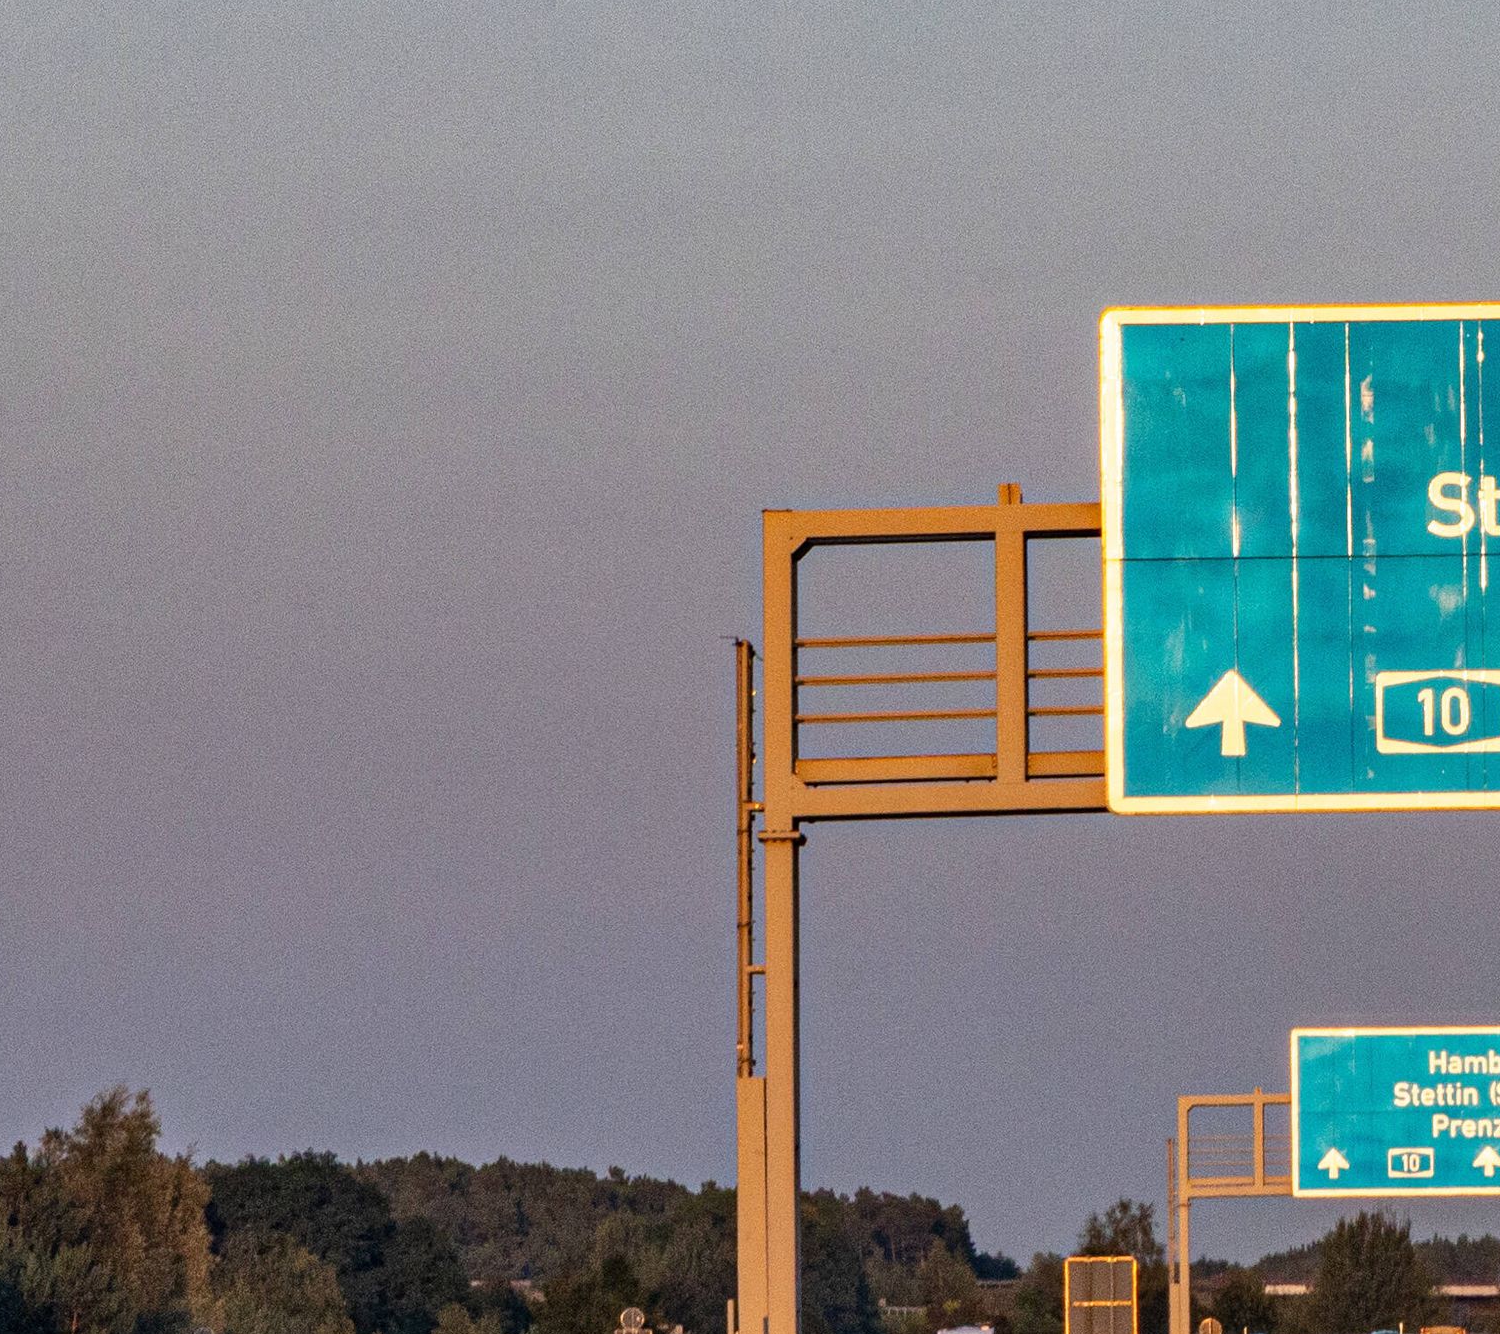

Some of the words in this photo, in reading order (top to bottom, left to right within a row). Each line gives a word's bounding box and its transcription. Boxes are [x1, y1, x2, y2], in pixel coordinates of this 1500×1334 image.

[1417, 686, 1470, 736] 10
[1393, 1081, 1480, 1107] Stettin
[1402, 1154, 1420, 1172] 10
